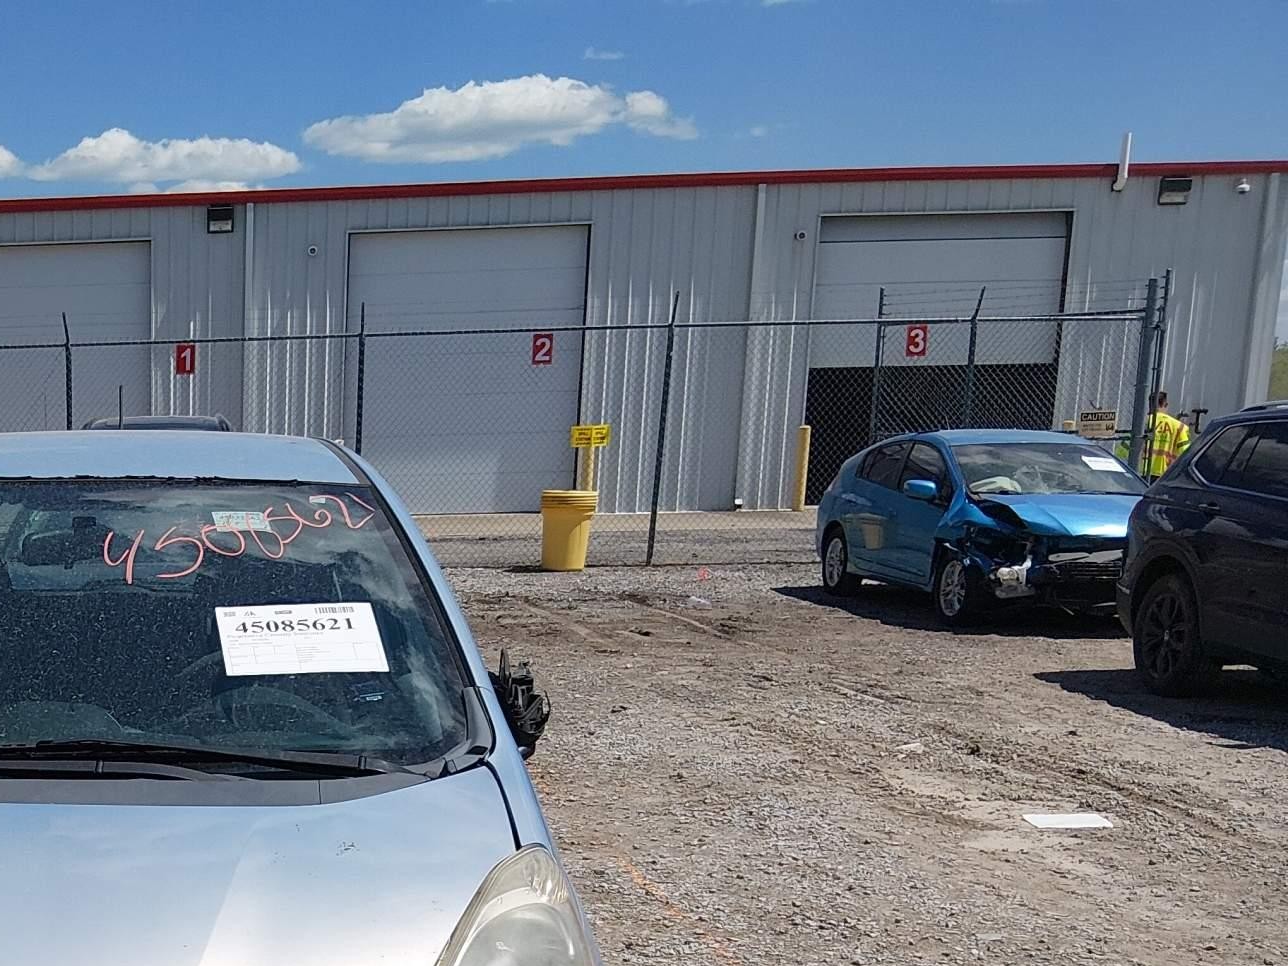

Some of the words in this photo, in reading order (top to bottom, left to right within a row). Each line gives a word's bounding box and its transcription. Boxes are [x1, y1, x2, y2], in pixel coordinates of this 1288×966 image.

[535, 337, 551, 361] 2
[909, 329, 925, 353] 3
[180, 348, 191, 371] 1
[1082, 412, 1115, 421] CAUTION
[235, 617, 356, 634] 45085621
